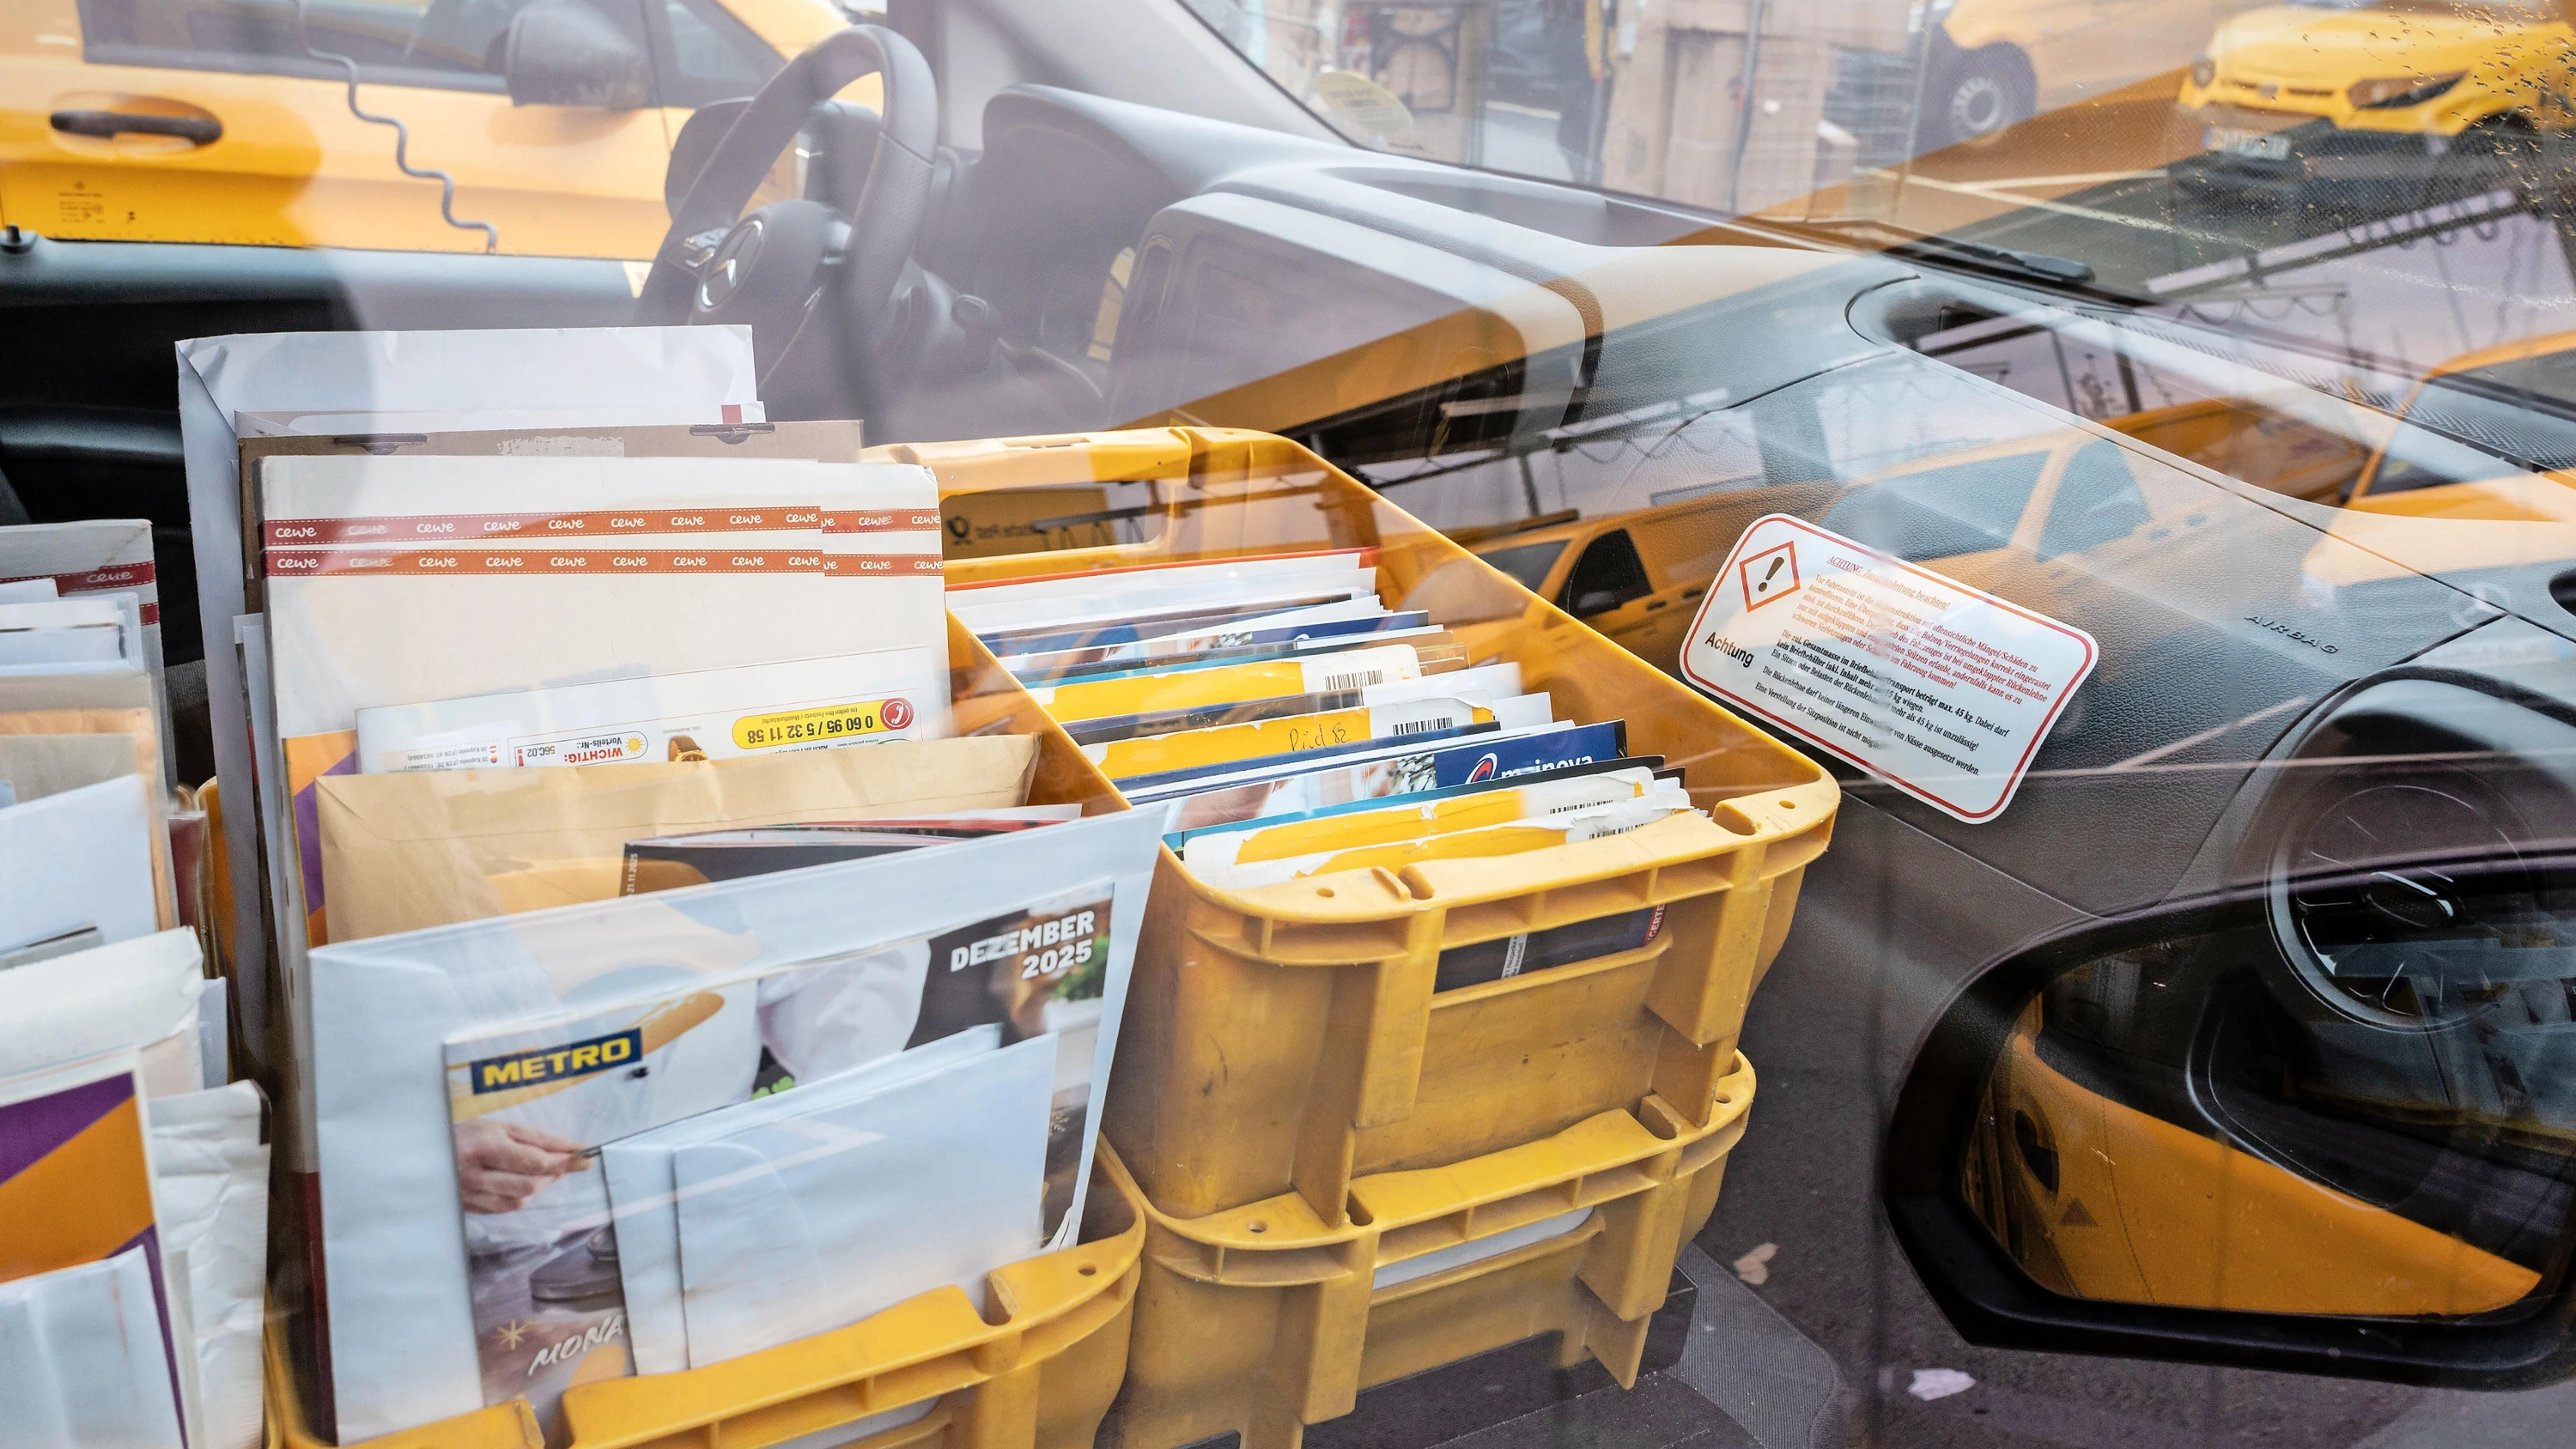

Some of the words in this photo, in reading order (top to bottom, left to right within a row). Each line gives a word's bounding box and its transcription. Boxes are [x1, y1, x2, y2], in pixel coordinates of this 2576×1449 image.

[276, 527, 317, 538] cewe
[416, 523, 456, 533] cewe
[483, 520, 521, 531] cewe
[548, 518, 585, 530] cewe
[611, 518, 646, 528] cewe
[671, 515, 705, 526] cewe
[729, 514, 762, 524] cewe
[786, 512, 818, 524] cewe
[911, 515, 941, 524] cewe
[86, 571, 133, 583] cewe
[276, 558, 319, 569] cewe
[418, 557, 458, 567] cewe
[485, 556, 524, 567] cewe
[550, 556, 587, 567] cewe
[613, 556, 648, 567] cewe
[673, 555, 708, 567] cewe
[732, 556, 765, 567] cewe
[788, 556, 821, 567] cewe
[860, 560, 892, 570] cewe
[914, 560, 944, 570] cewe
[1828, 555, 1863, 575] ACHTUNG:
[1917, 591, 1951, 609] beachten!
[1808, 584, 1843, 604] kontrollieren.
[1845, 599, 1857, 609] Eine
[1896, 621, 1910, 631] dass
[1910, 627, 1922, 636] alle
[1922, 631, 1990, 664] Bolzen/Verriegelungen
[1990, 660, 2015, 675] korrekt
[2014, 671, 2051, 690] eingerastet
[1815, 575, 1826, 585] Vor
[1826, 579, 1858, 597] Fahrtantritt
[1857, 592, 1866, 601] ist
[1865, 596, 1874, 604] die
[1933, 625, 1977, 647] offensichtliche
[1977, 642, 2029, 669] Mängel/Schäden
[2244, 615, 2339, 653] AIRBAG
[1704, 631, 1754, 668] Achtung
[1792, 614, 1817, 627] schweren
[1818, 623, 1852, 643] Verletzungen
[1853, 640, 1866, 649] oder
[1900, 659, 1928, 678] Fahrzeug
[1928, 671, 1958, 689] kommen!
[1803, 594, 1816, 604] sind,
[1867, 620, 1877, 629] Der
[1899, 634, 1910, 643] des
[1910, 639, 1943, 658] Fahrzeuges
[1944, 652, 1953, 661] ist
[1953, 656, 1964, 666] bei
[1963, 663, 2006, 684] umgeklappter
[2007, 679, 2048, 702] Rückenlehne
[1818, 613, 1856, 633] aufgeklappten
[1856, 629, 1868, 638] und
[1905, 649, 1929, 664] Stützen
[1929, 661, 1952, 676] erlaubt,
[1953, 671, 1987, 689] andernfalls
[1988, 684, 2004, 697] kann
[1777, 640, 1789, 651] kein
[1789, 646, 1826, 667] Briefbehälter
[1826, 662, 1839, 674] inkl.
[1840, 669, 1860, 682] Inhalt
[1858, 679, 1874, 689] mehr
[1893, 693, 1902, 704] kg
[1902, 699, 1923, 712] wiegen.
[1782, 630, 1791, 640] Die
[1791, 636, 1802, 645] zul.
[1803, 640, 1841, 661] Gesamtmasse
[1841, 657, 1850, 665] im
[1916, 690, 1939, 706] beträgt
[1938, 702, 1953, 712] max.
[1955, 707, 1965, 717] 45
[1965, 712, 1973, 723] kg.
[1975, 717, 1996, 731] Dabei
[1994, 725, 2010, 737] darf
[1755, 682, 1767, 694] Eine
[1767, 688, 1797, 710] Verstellung
[1796, 703, 1807, 712] der
[1807, 707, 1838, 728] Sitzposition
[1838, 724, 1847, 732] ist
[1846, 729, 1862, 740] nicht
[1771, 649, 1781, 658] Ein
[1781, 654, 1798, 666] Sitzen
[1798, 663, 1810, 672] oder
[1811, 668, 1833, 683] Belasten
[1833, 678, 1844, 688] der
[1890, 706, 1906, 717] mehr
[1917, 716, 1926, 725] 45
[1925, 720, 1934, 731] kg
[1934, 724, 1944, 734] ist
[1943, 731, 1979, 751] unzulässig!
[748, 730, 764, 743] 58
[769, 727, 783, 741] 11
[787, 724, 803, 739] 32
[807, 723, 815, 736] 5
[827, 719, 842, 734] 95
[847, 718, 862, 731] 60
[866, 715, 873, 728] 0
[1763, 666, 1772, 676] Die
[1772, 670, 1806, 692] Rückenlehne
[1806, 687, 1819, 697] darf
[1817, 692, 1835, 706] keiner
[1835, 700, 1860, 718] längeren
[1893, 731, 1905, 739] von
[1905, 734, 1923, 749] Nässe
[1923, 745, 1956, 763] ausgesetzt
[1955, 761, 1978, 776] werden.
[527, 745, 556, 757] 56C.02
[564, 748, 623, 763] WICHTIG:
[577, 737, 623, 749] Vorteils-Nr.:
[1501, 755, 1593, 779] minova
[950, 910, 1095, 973] DEZEMBER
[1022, 938, 1092, 979] 2025
[483, 1036, 631, 1087] METRO
[527, 1314, 625, 1376] MONA
